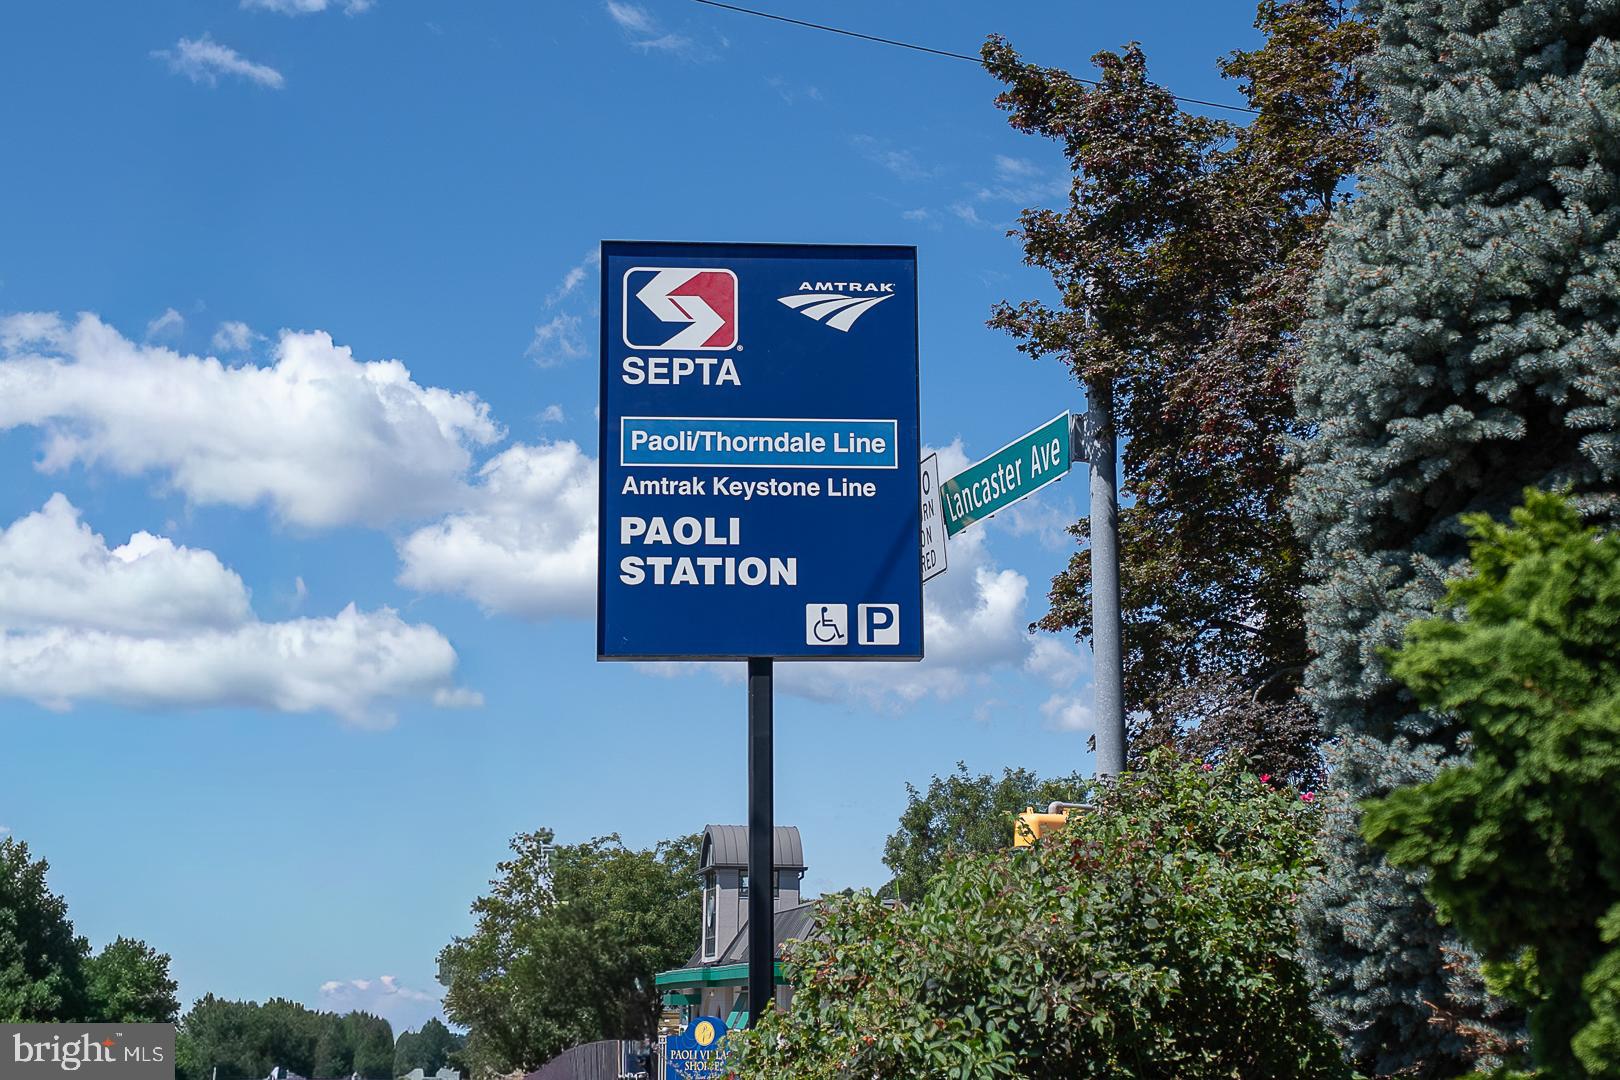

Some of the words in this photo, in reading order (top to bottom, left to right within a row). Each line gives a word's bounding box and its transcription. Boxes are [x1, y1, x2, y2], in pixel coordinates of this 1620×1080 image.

[798, 281, 895, 292] AMTRAK
[621, 356, 742, 386] SEPTA
[630, 430, 826, 453] Paoli/Thorndale
[833, 432, 886, 453] Line
[621, 476, 705, 496] Amtrak
[713, 476, 820, 500] Keystone
[827, 478, 876, 497] Line
[922, 470, 930, 496] O
[946, 457, 1022, 522] Lancaster
[1031, 438, 1060, 479] Ave
[619, 516, 740, 546] PAOLI
[921, 525, 932, 548] ON
[619, 556, 797, 586] STATION
[921, 549, 936, 573] RED
[670, 1050, 697, 1060] PAOLI
[699, 1050, 732, 1060] VILA
